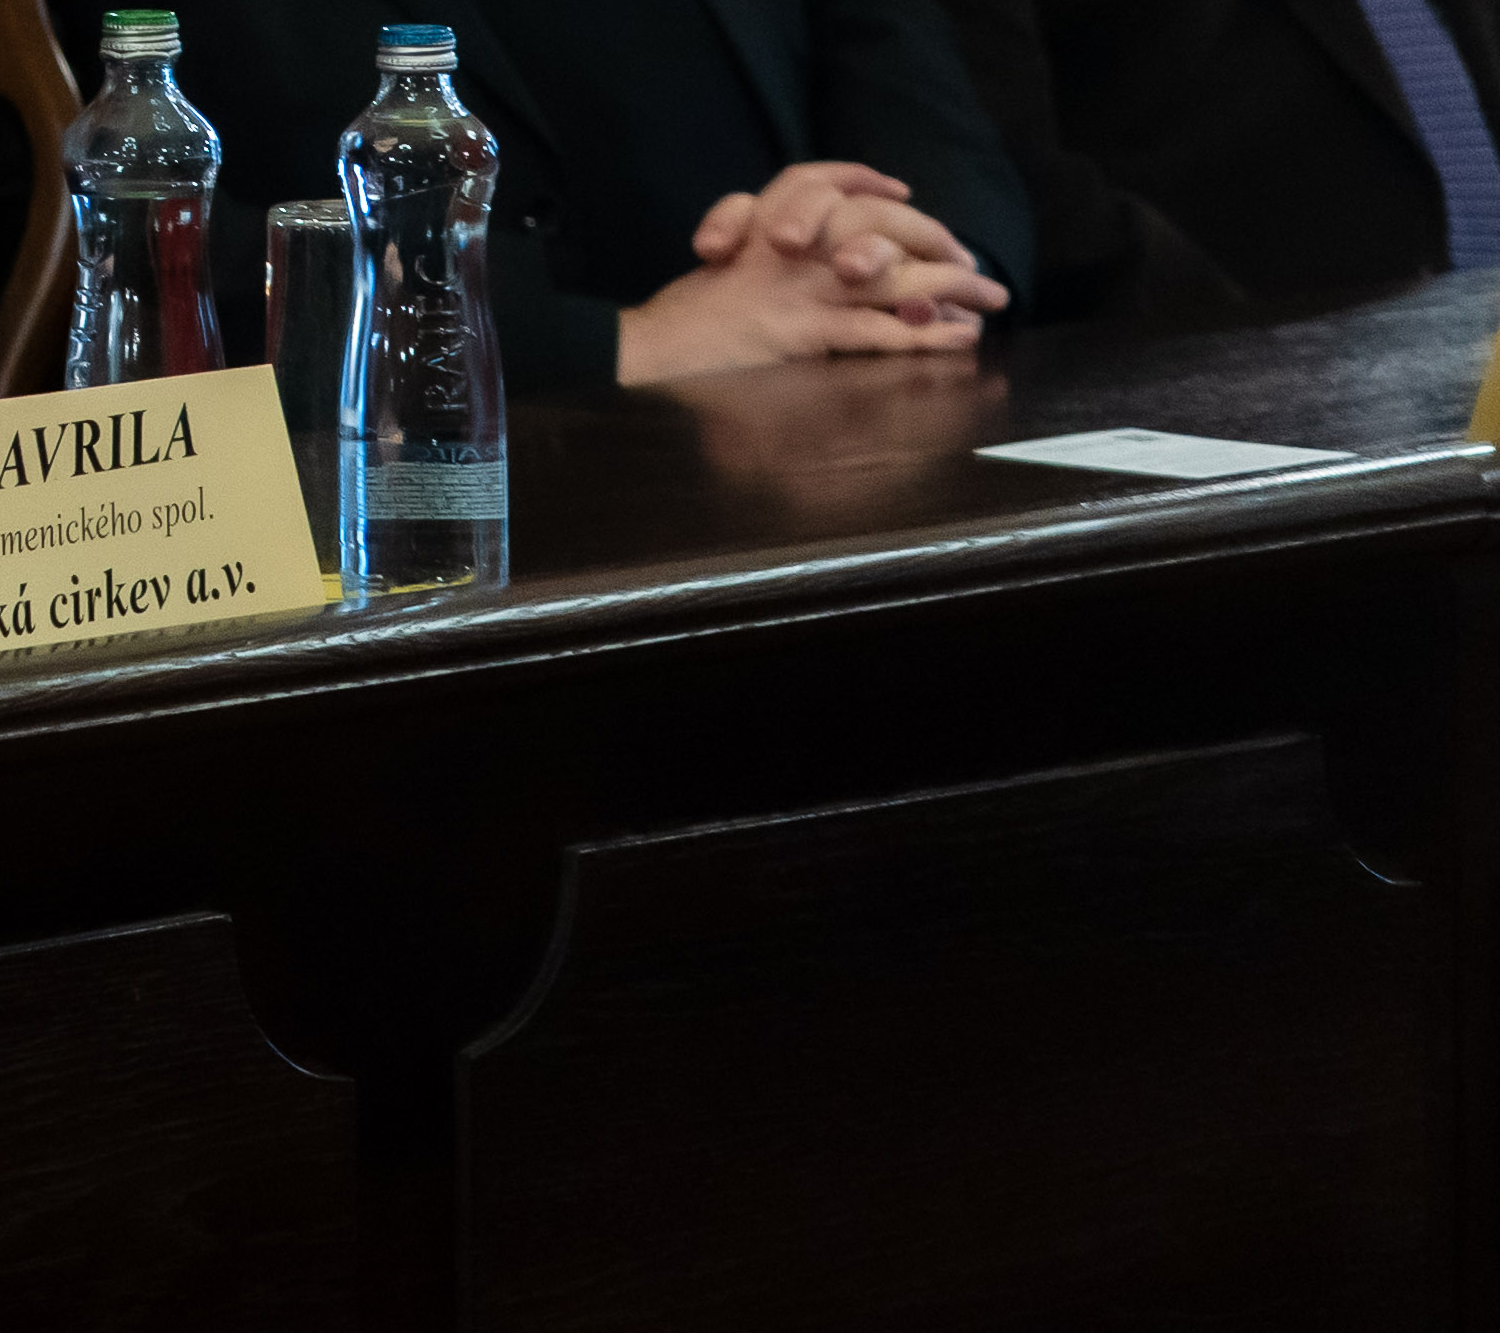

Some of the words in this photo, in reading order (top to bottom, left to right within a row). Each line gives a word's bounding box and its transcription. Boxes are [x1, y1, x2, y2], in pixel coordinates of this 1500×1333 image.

[151, 486, 215, 539] spol.
[49, 559, 172, 630] cirkev
[186, 555, 255, 603] a.v.
